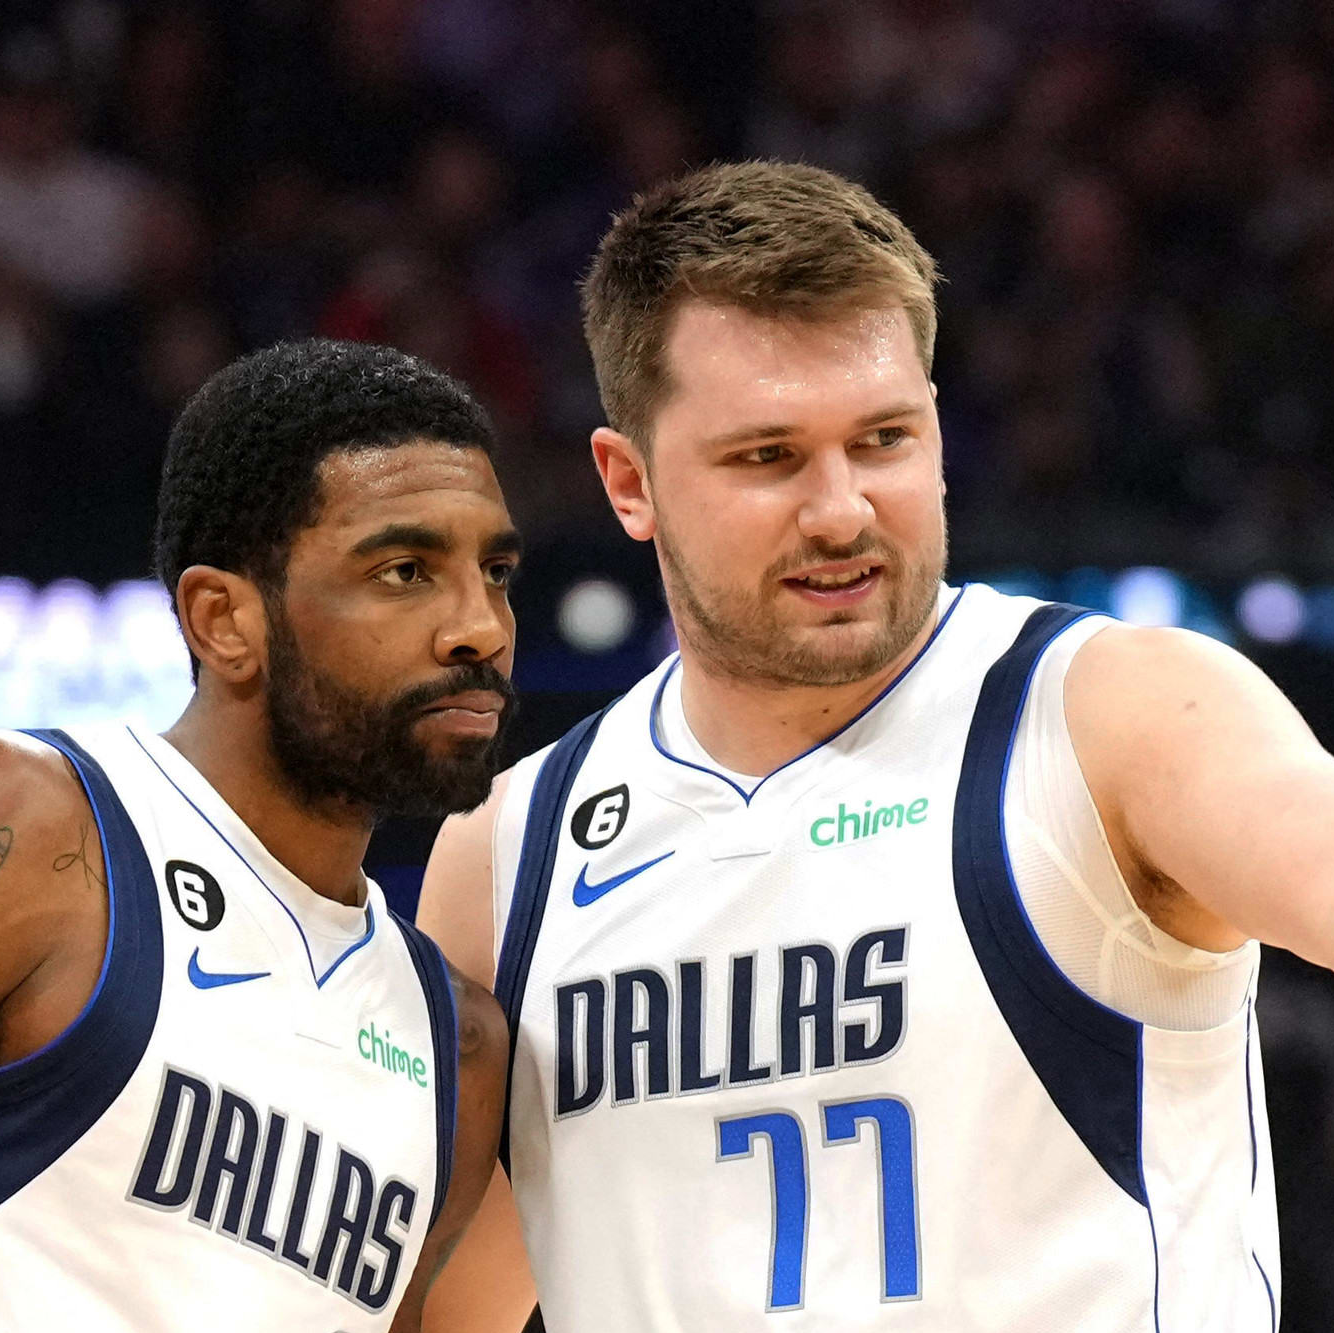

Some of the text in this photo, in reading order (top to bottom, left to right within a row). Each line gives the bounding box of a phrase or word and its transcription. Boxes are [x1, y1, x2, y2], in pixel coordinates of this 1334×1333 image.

[585, 792, 623, 843] 6
[810, 797, 929, 847] chime
[174, 868, 210, 924] 6
[553, 921, 912, 1122] DALLAS
[357, 1022, 428, 1088] chime
[125, 1062, 419, 1315] DALLAS
[714, 1092, 923, 1314] 77
